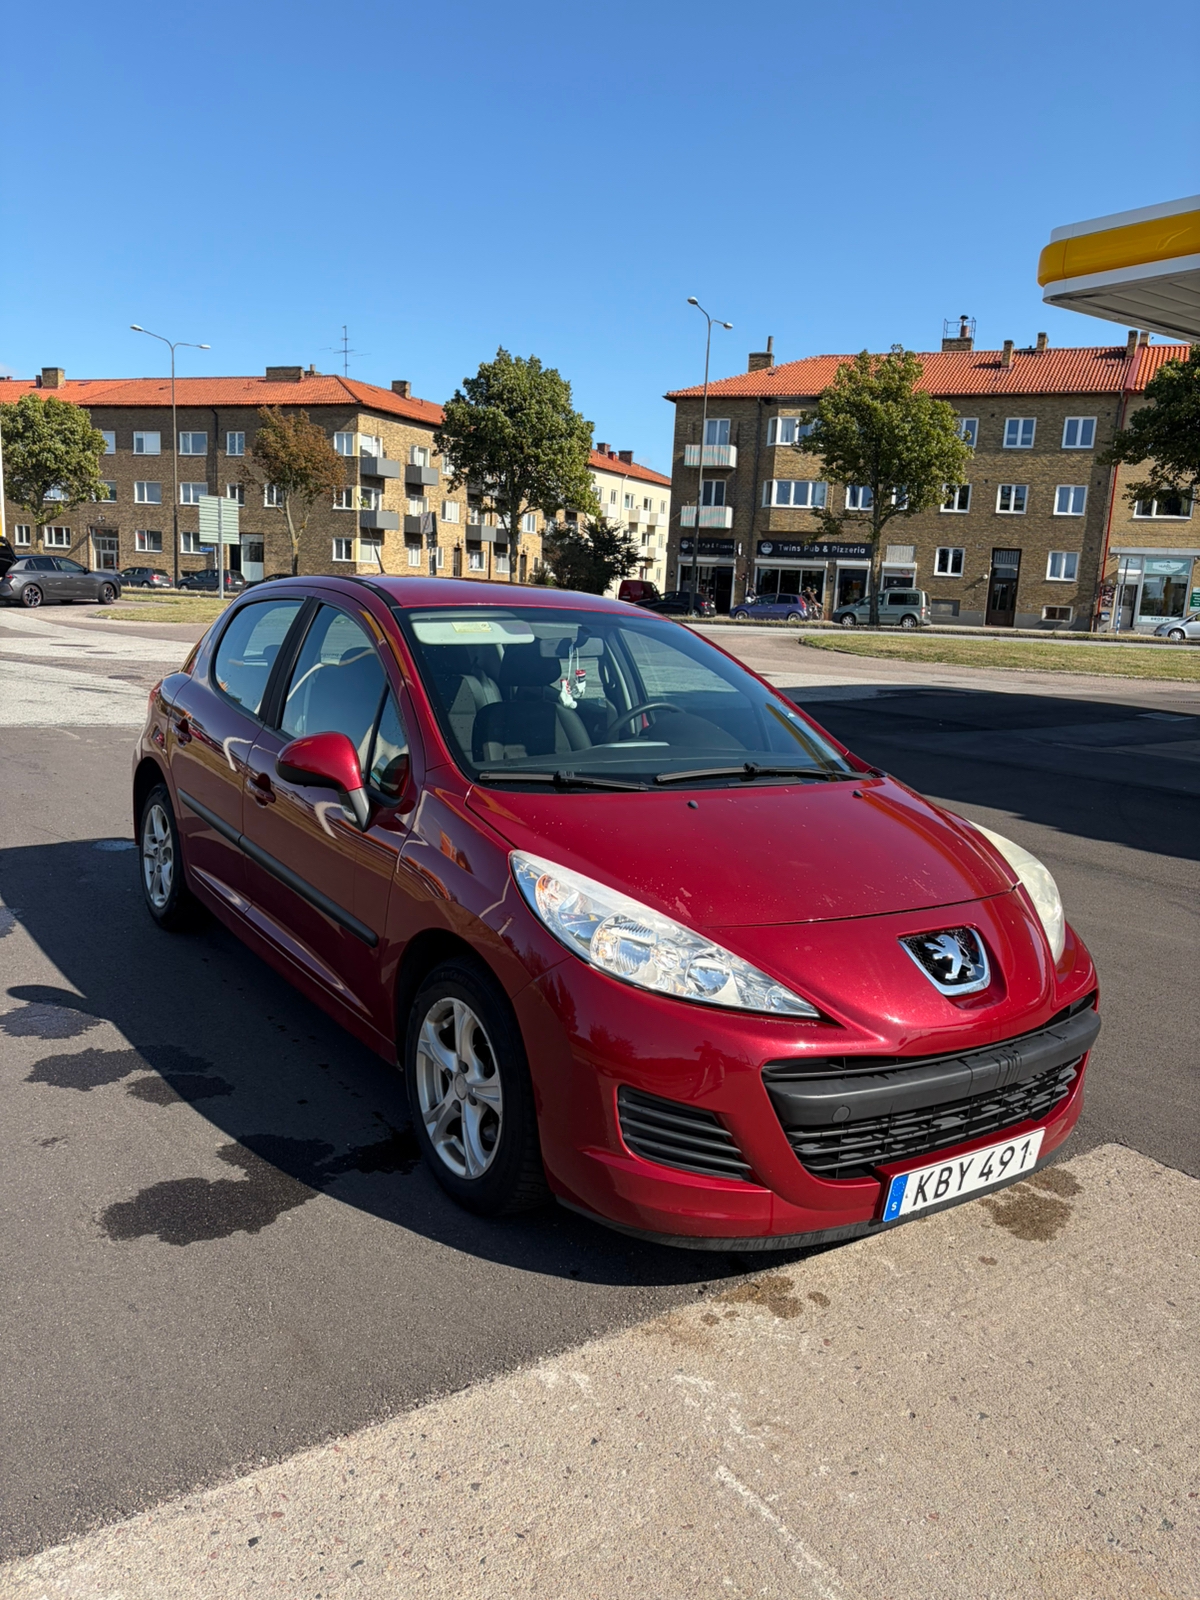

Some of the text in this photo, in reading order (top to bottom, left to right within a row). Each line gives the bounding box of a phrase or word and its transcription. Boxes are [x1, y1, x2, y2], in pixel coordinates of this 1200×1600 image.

[778, 544, 866, 554] Twins Pub & Pizzeria
[912, 1138, 1031, 1206] KBY 491
[891, 1201, 898, 1211] S
